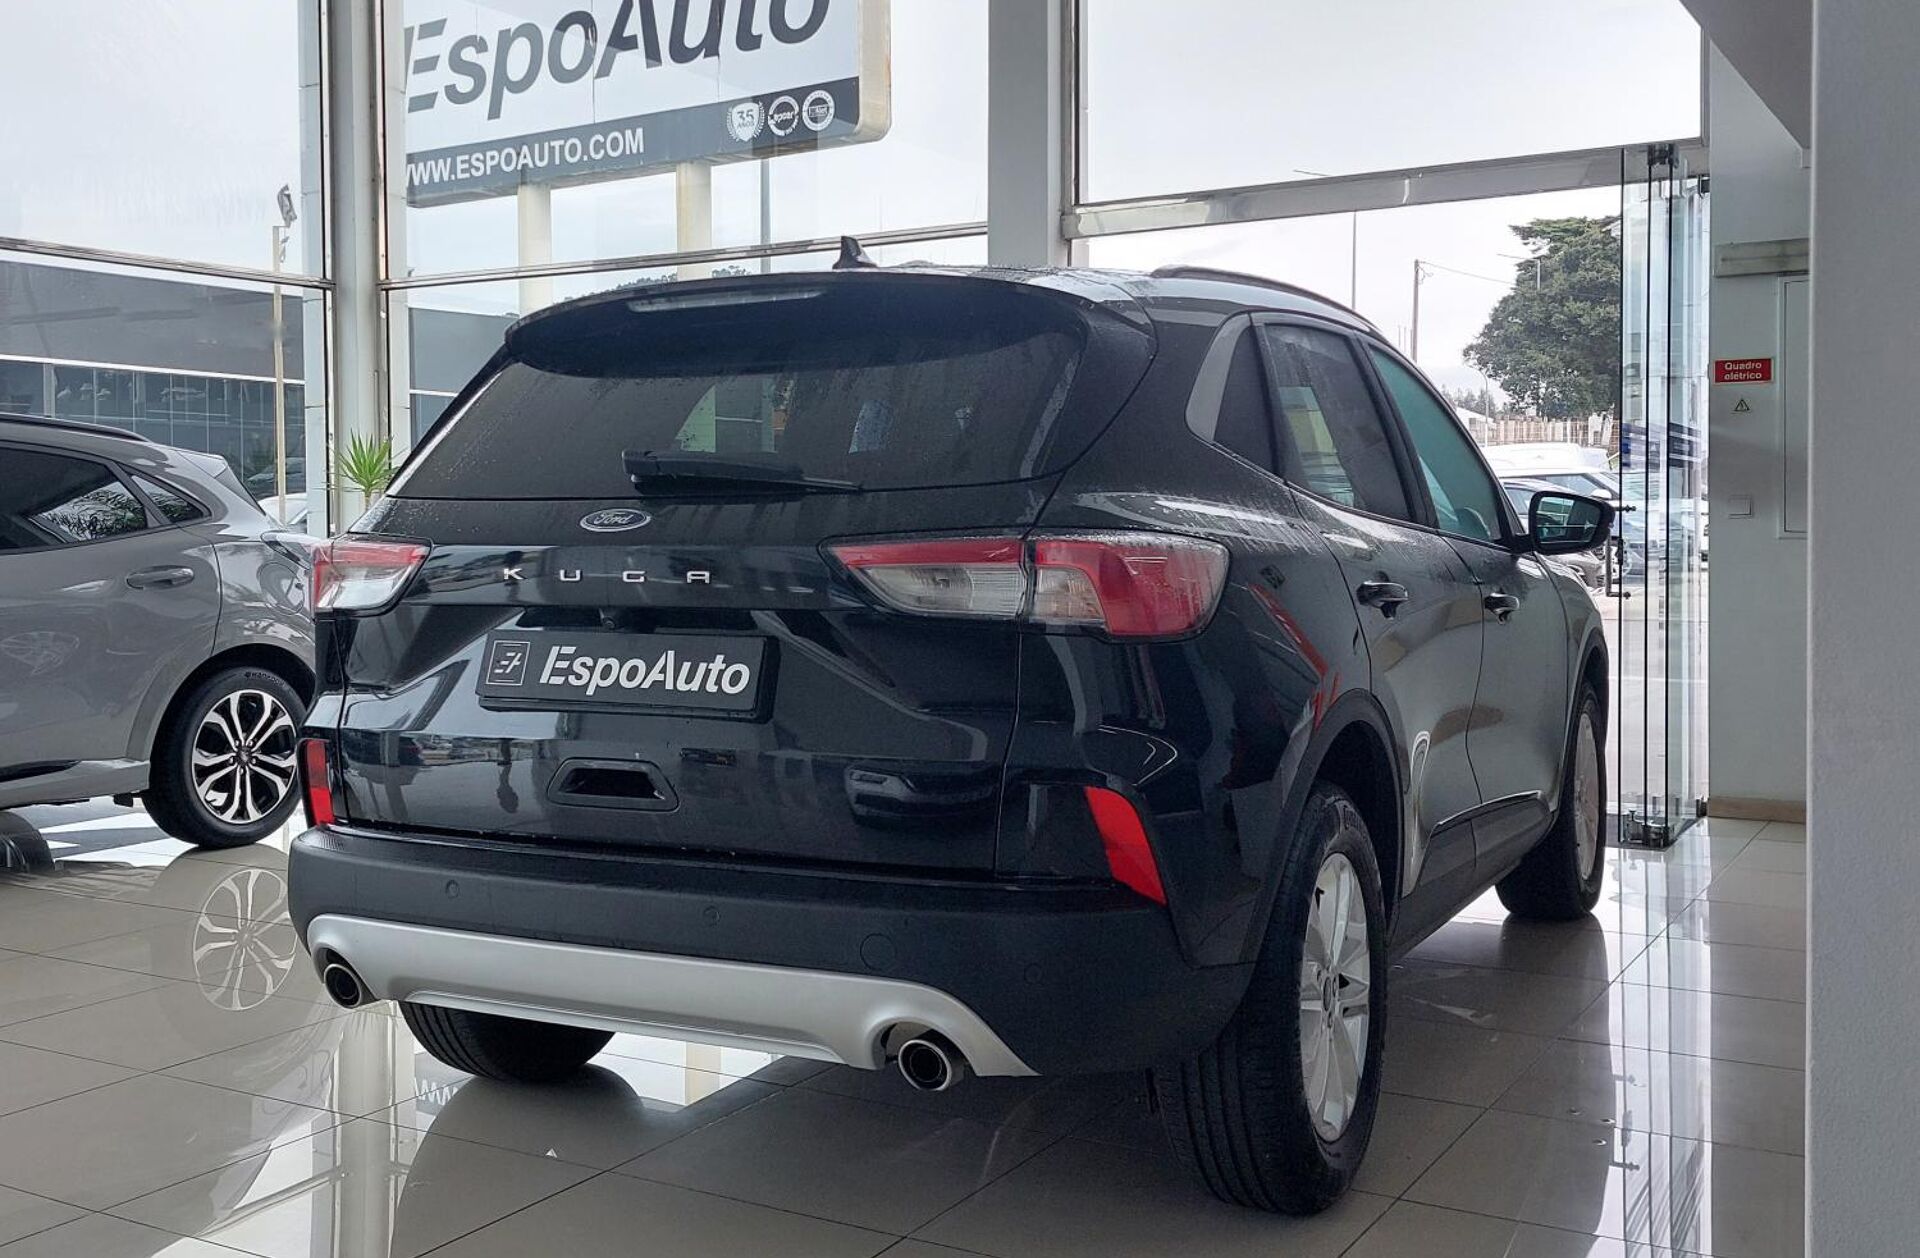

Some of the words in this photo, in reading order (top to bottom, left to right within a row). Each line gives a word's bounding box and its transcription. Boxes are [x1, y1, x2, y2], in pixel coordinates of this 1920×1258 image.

[1724, 361, 1762, 370] Quadro
[1724, 371, 1762, 380] elétrico
[593, 514, 634, 525] Ford
[503, 567, 710, 584] KUGA
[539, 645, 750, 696] EspoAuto
